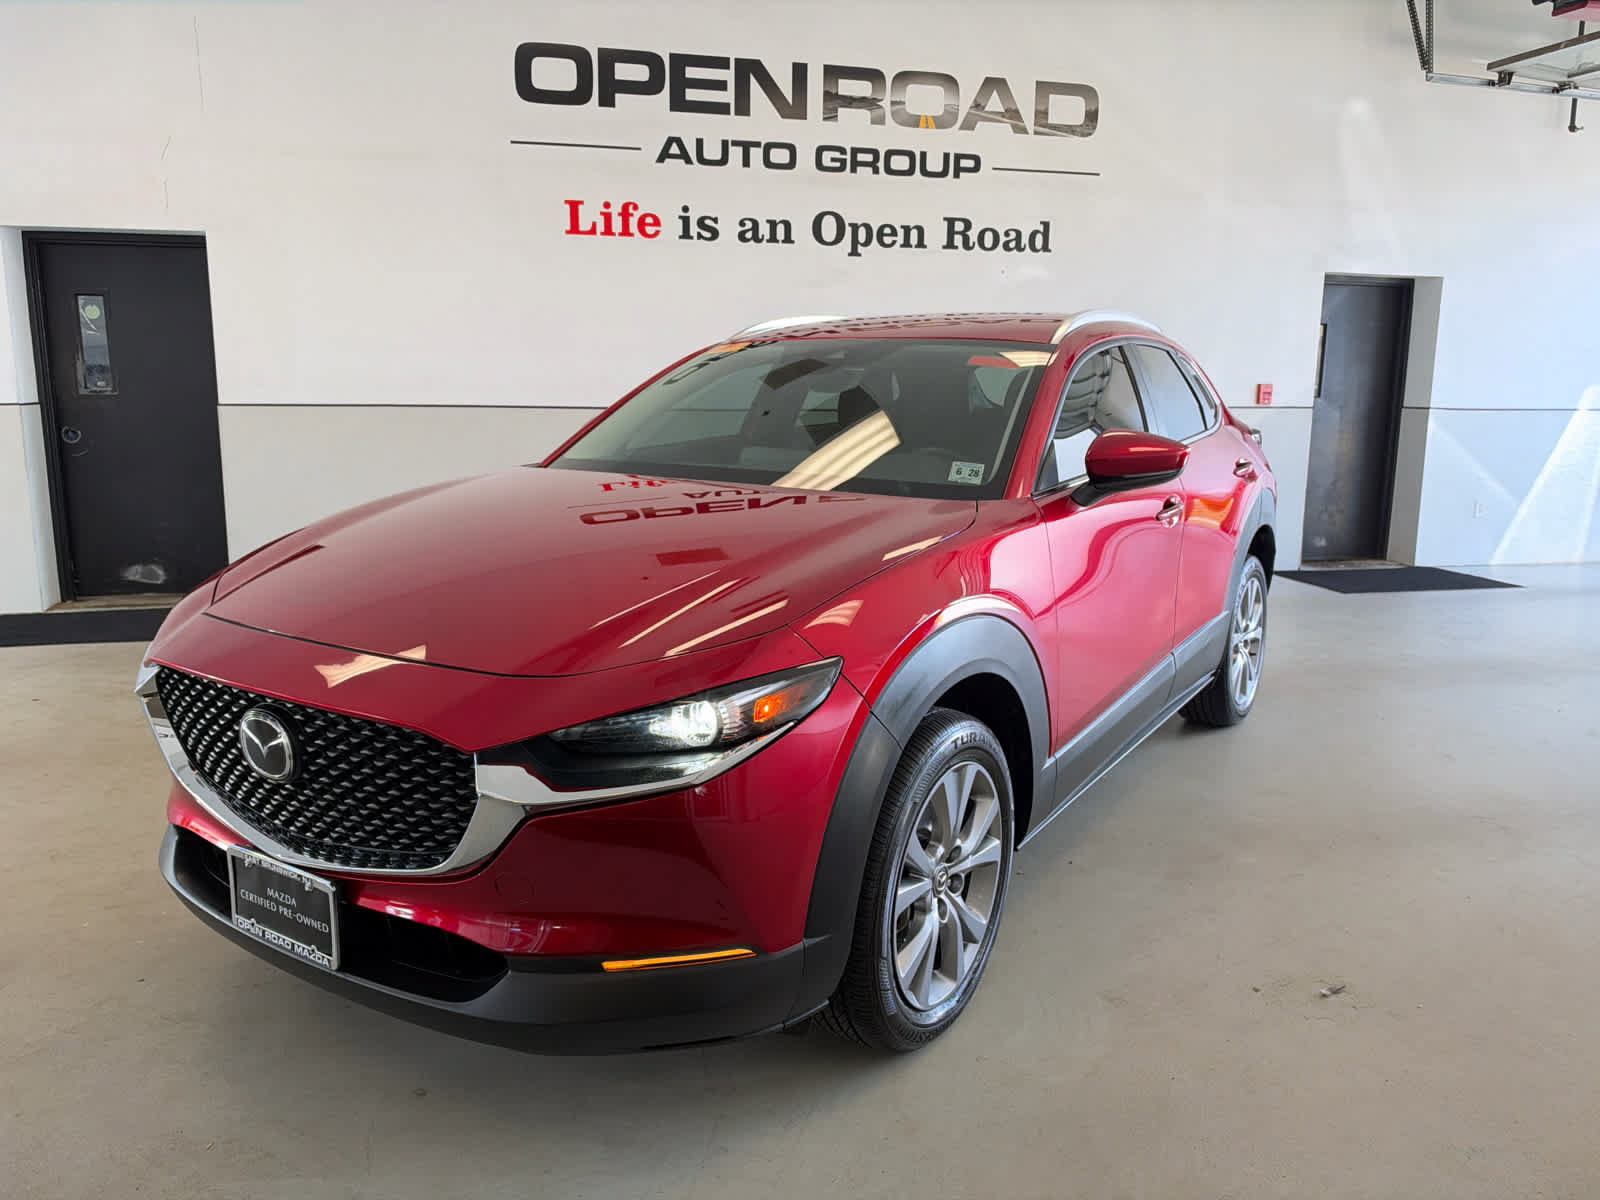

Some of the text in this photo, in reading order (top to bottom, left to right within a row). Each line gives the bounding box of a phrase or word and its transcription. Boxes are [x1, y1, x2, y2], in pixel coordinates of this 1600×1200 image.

[514, 41, 1100, 138] OPEN ROAD
[656, 135, 982, 180] AUTO GROUP
[564, 199, 1053, 259] Life is an Open Road
[240, 888, 329, 933] CERTIFIED PRE-OWNED
[266, 887, 297, 907] MAZDA
[237, 919, 330, 967] OPEN ROAD MAZDA
